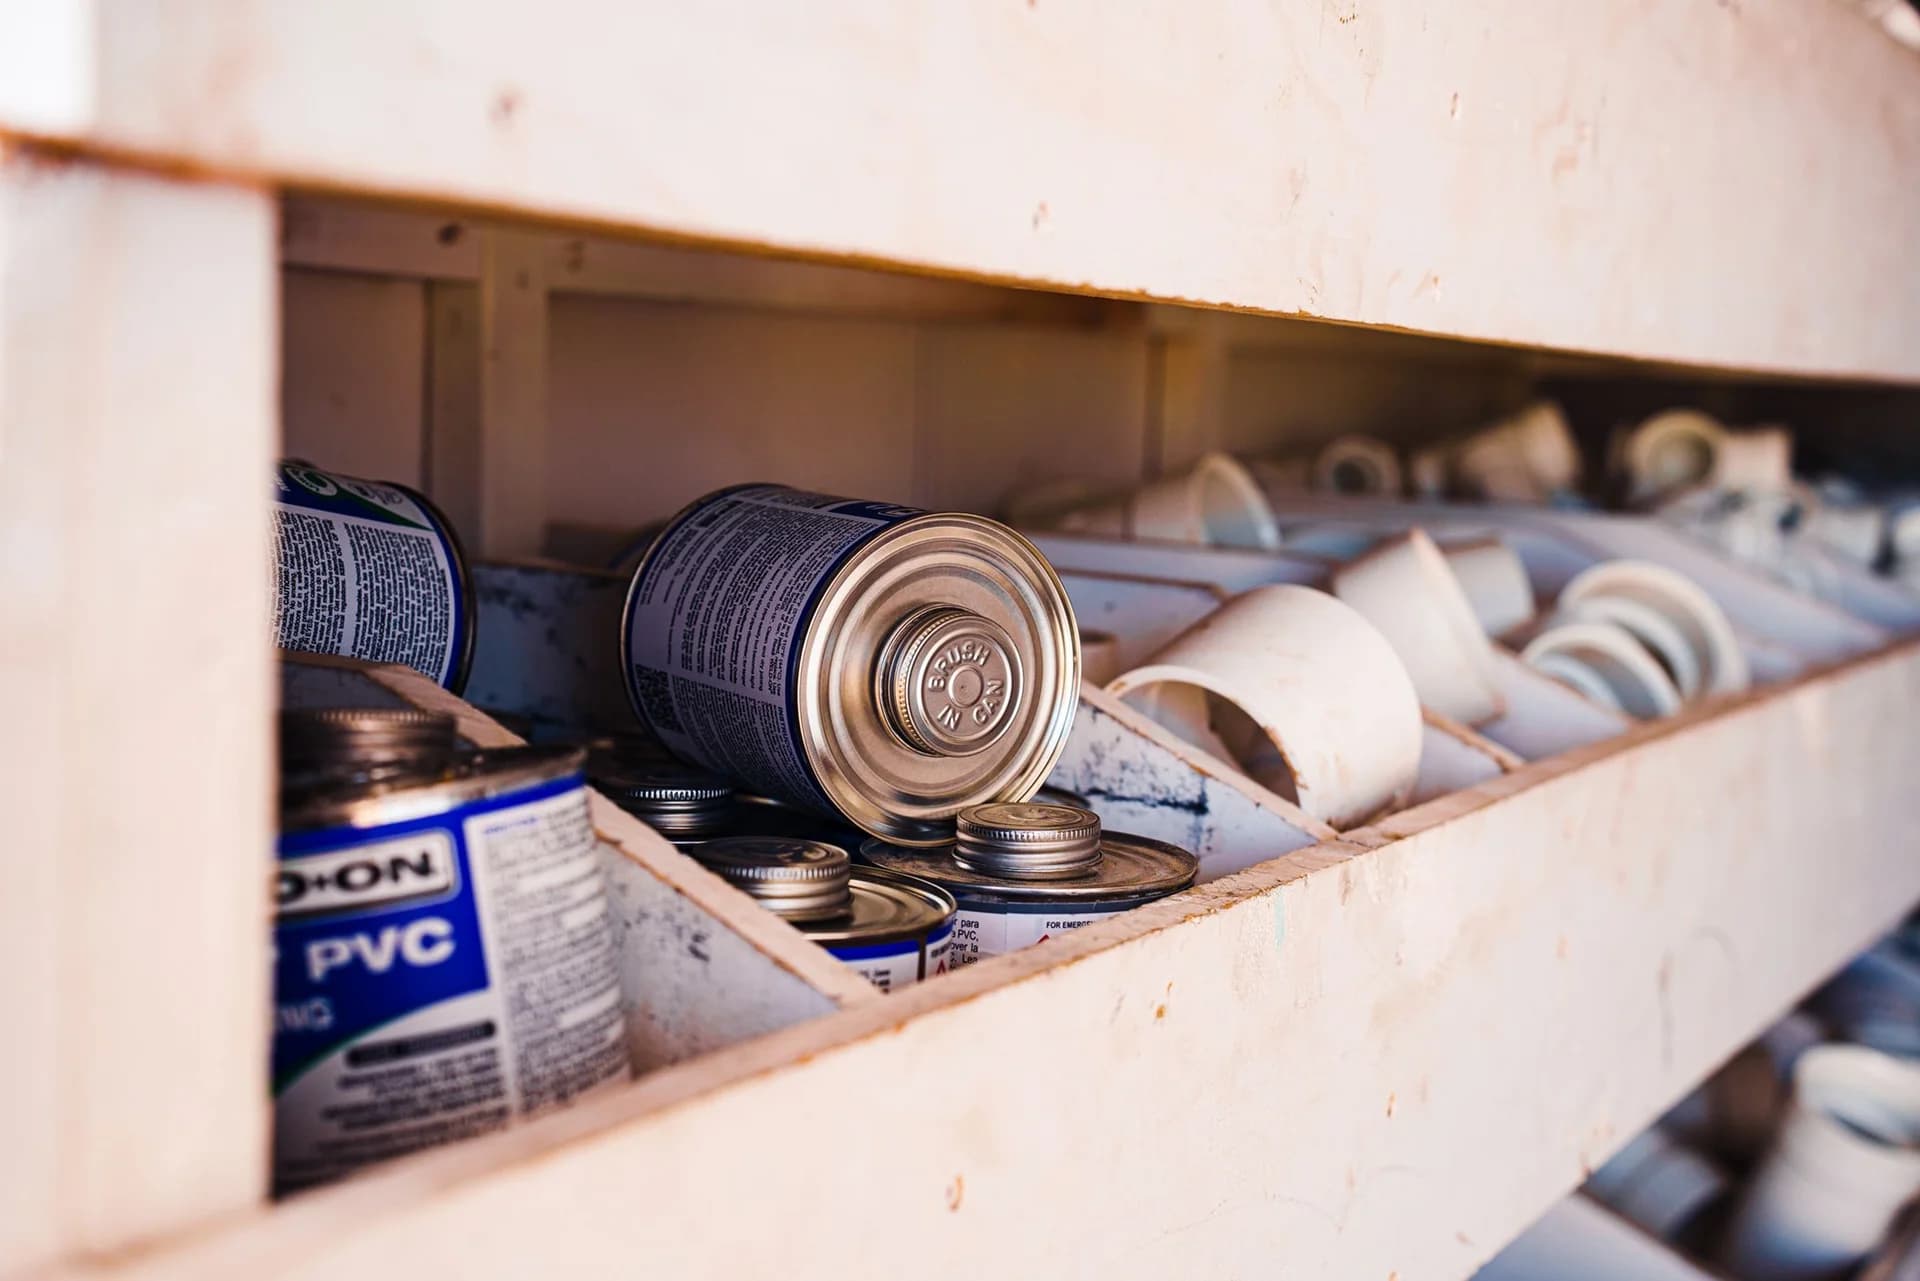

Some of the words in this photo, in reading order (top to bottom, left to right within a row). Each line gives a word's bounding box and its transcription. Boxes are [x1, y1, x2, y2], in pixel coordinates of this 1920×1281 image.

[928, 641, 992, 691] BRUSH
[937, 704, 961, 730] IN
[973, 680, 1003, 725] CAN
[957, 930, 979, 942] PVC,
[961, 919, 979, 929] para
[307, 917, 455, 983] PVC
[971, 943, 979, 952] la
